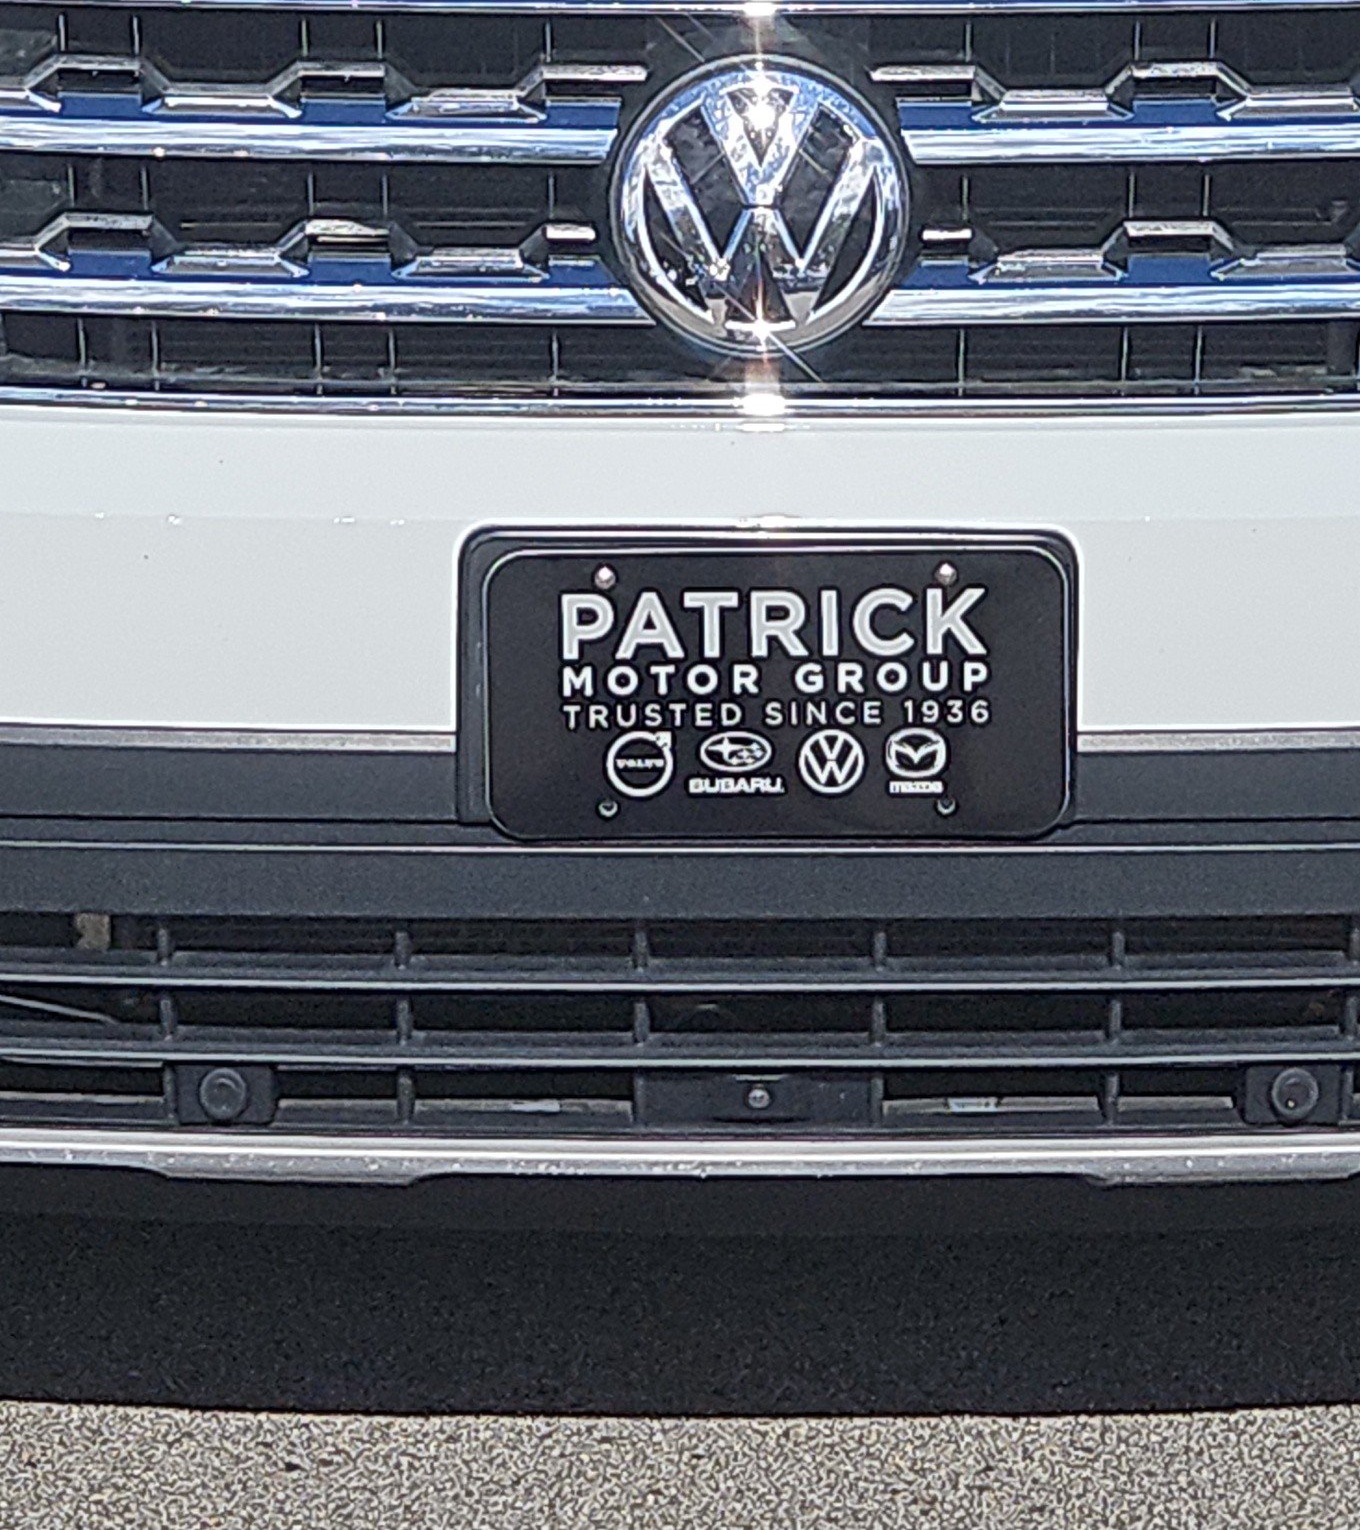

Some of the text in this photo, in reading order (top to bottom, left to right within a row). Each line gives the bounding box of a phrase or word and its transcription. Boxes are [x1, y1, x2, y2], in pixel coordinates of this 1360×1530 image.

[559, 587, 988, 660] PATRICK
[562, 661, 989, 697] MOTOR GROUP
[562, 698, 990, 730] TRUSTED SINCE 1936
[688, 776, 783, 794] SUBARU
